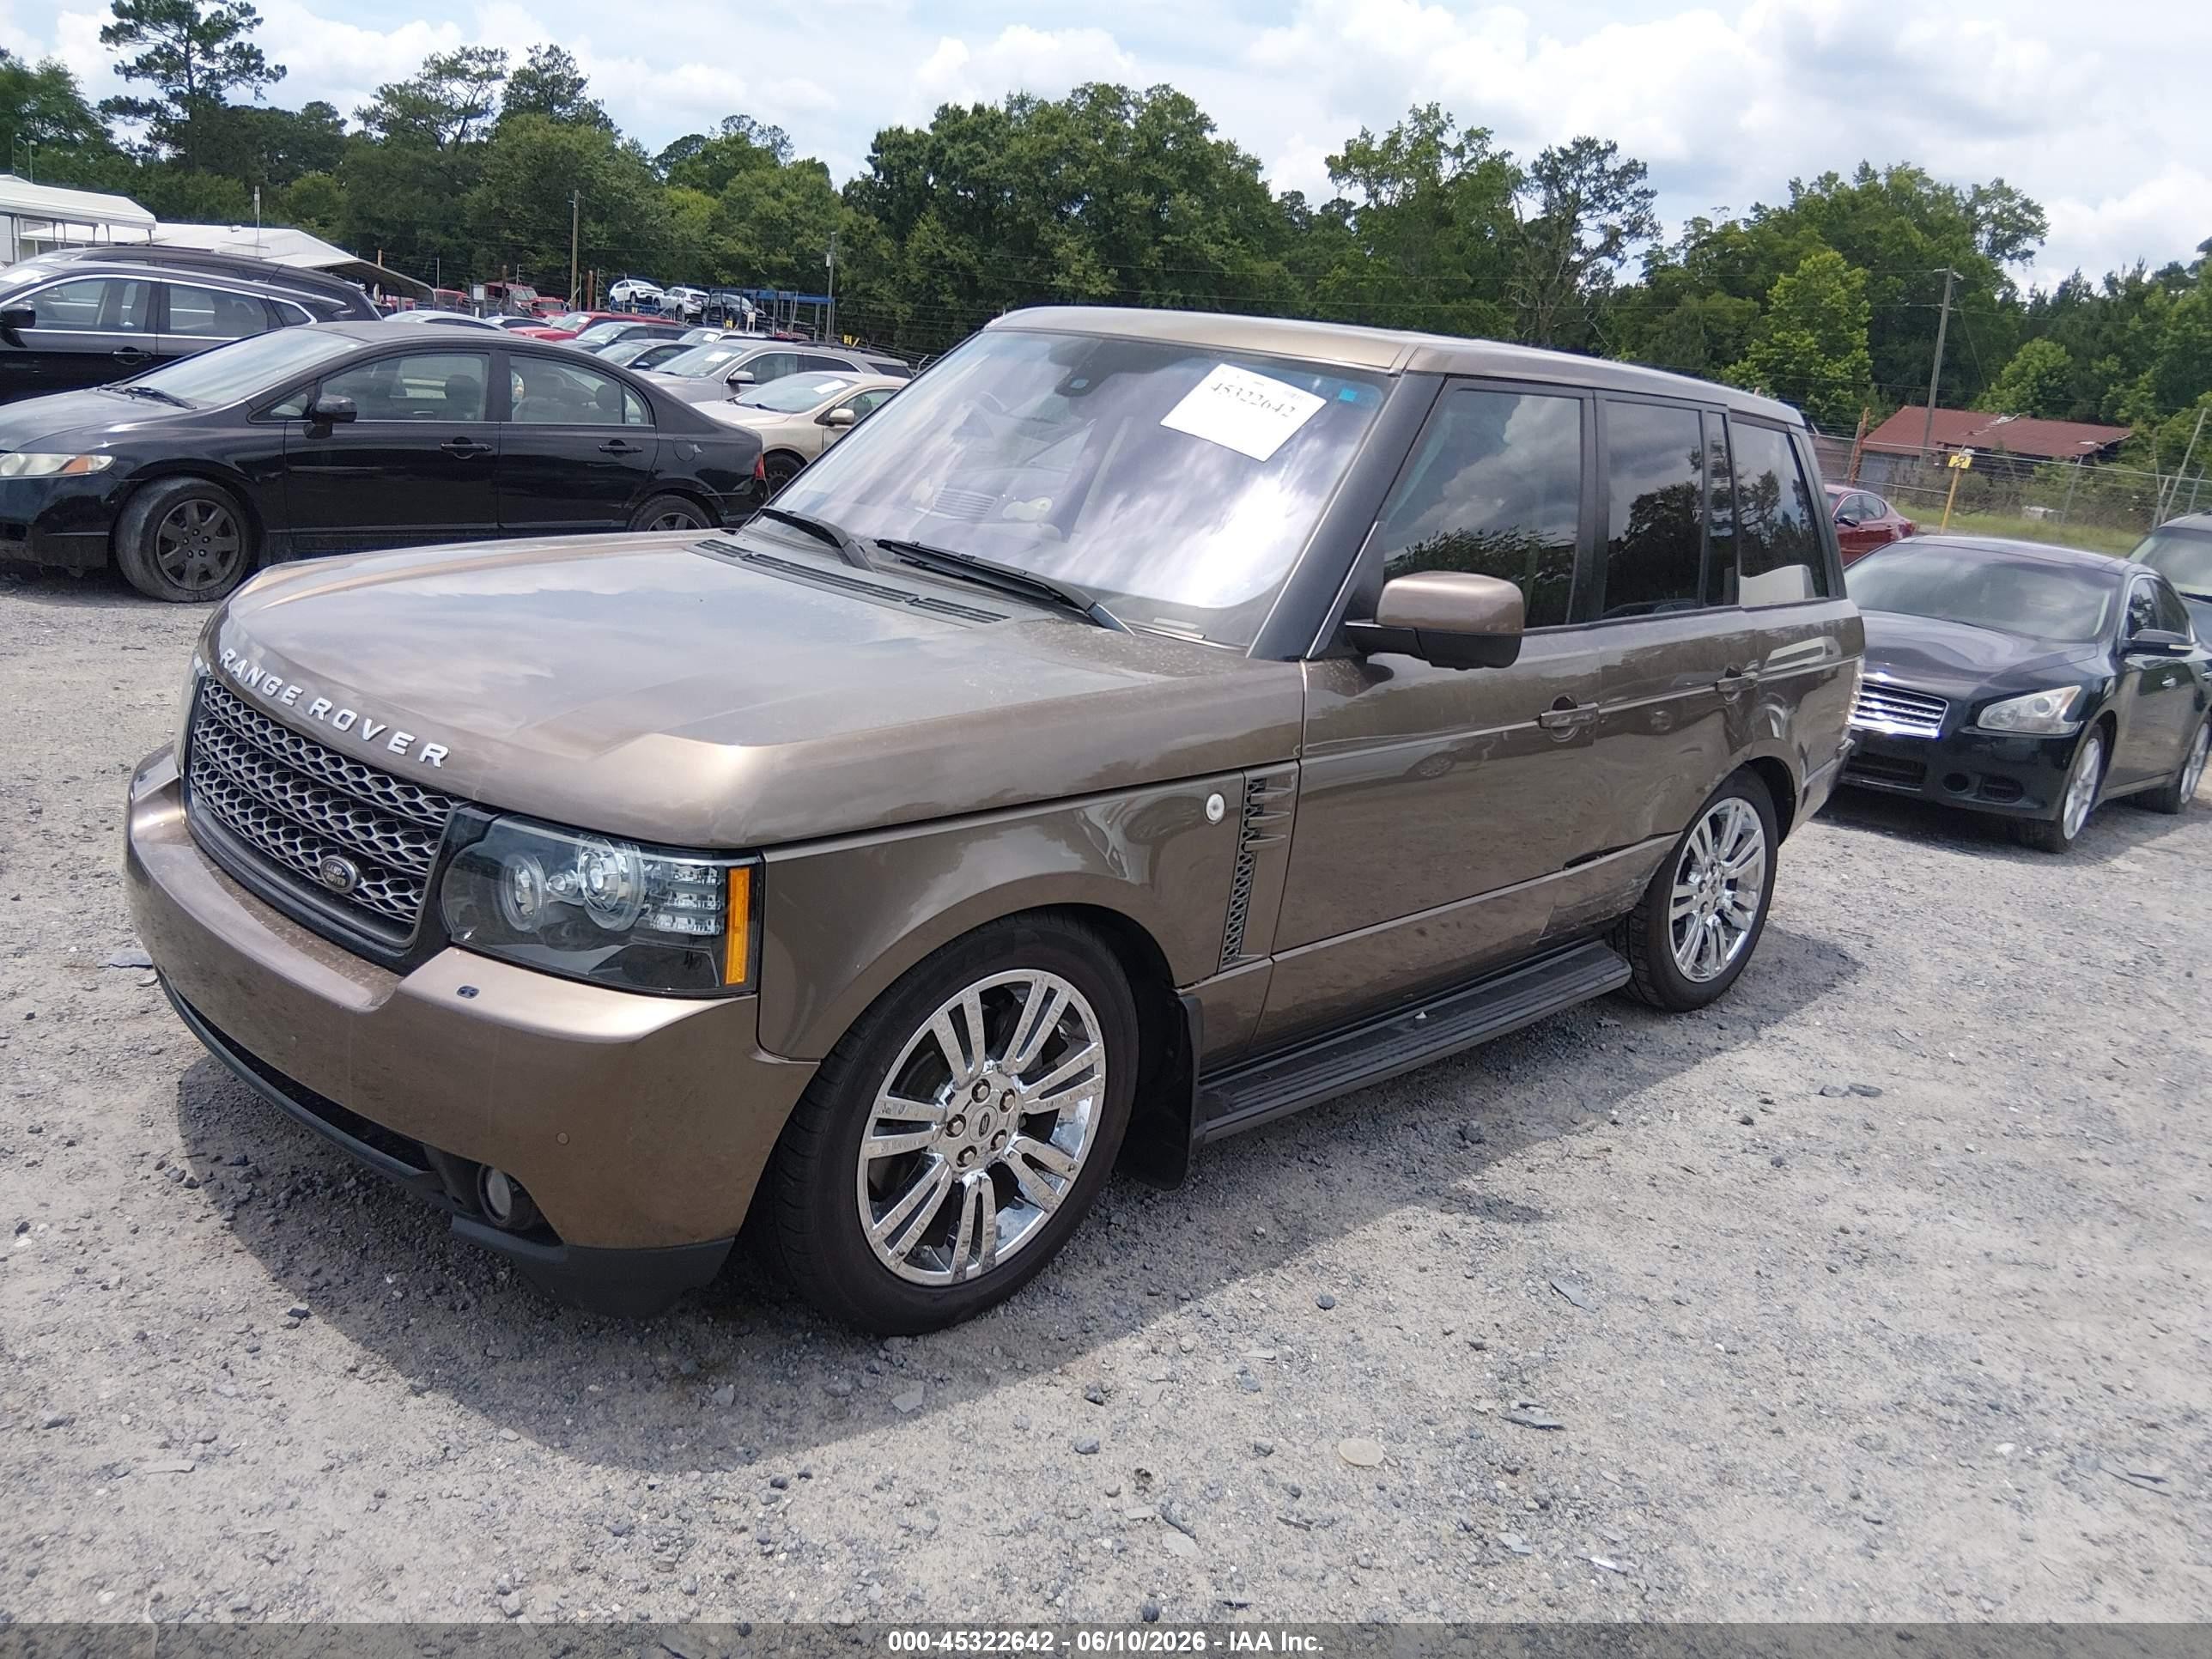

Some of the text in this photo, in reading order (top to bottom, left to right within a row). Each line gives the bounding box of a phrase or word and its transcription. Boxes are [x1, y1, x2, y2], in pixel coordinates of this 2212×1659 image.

[219, 647, 449, 768] RANGE ROVER
[325, 872, 346, 887] ROVER
